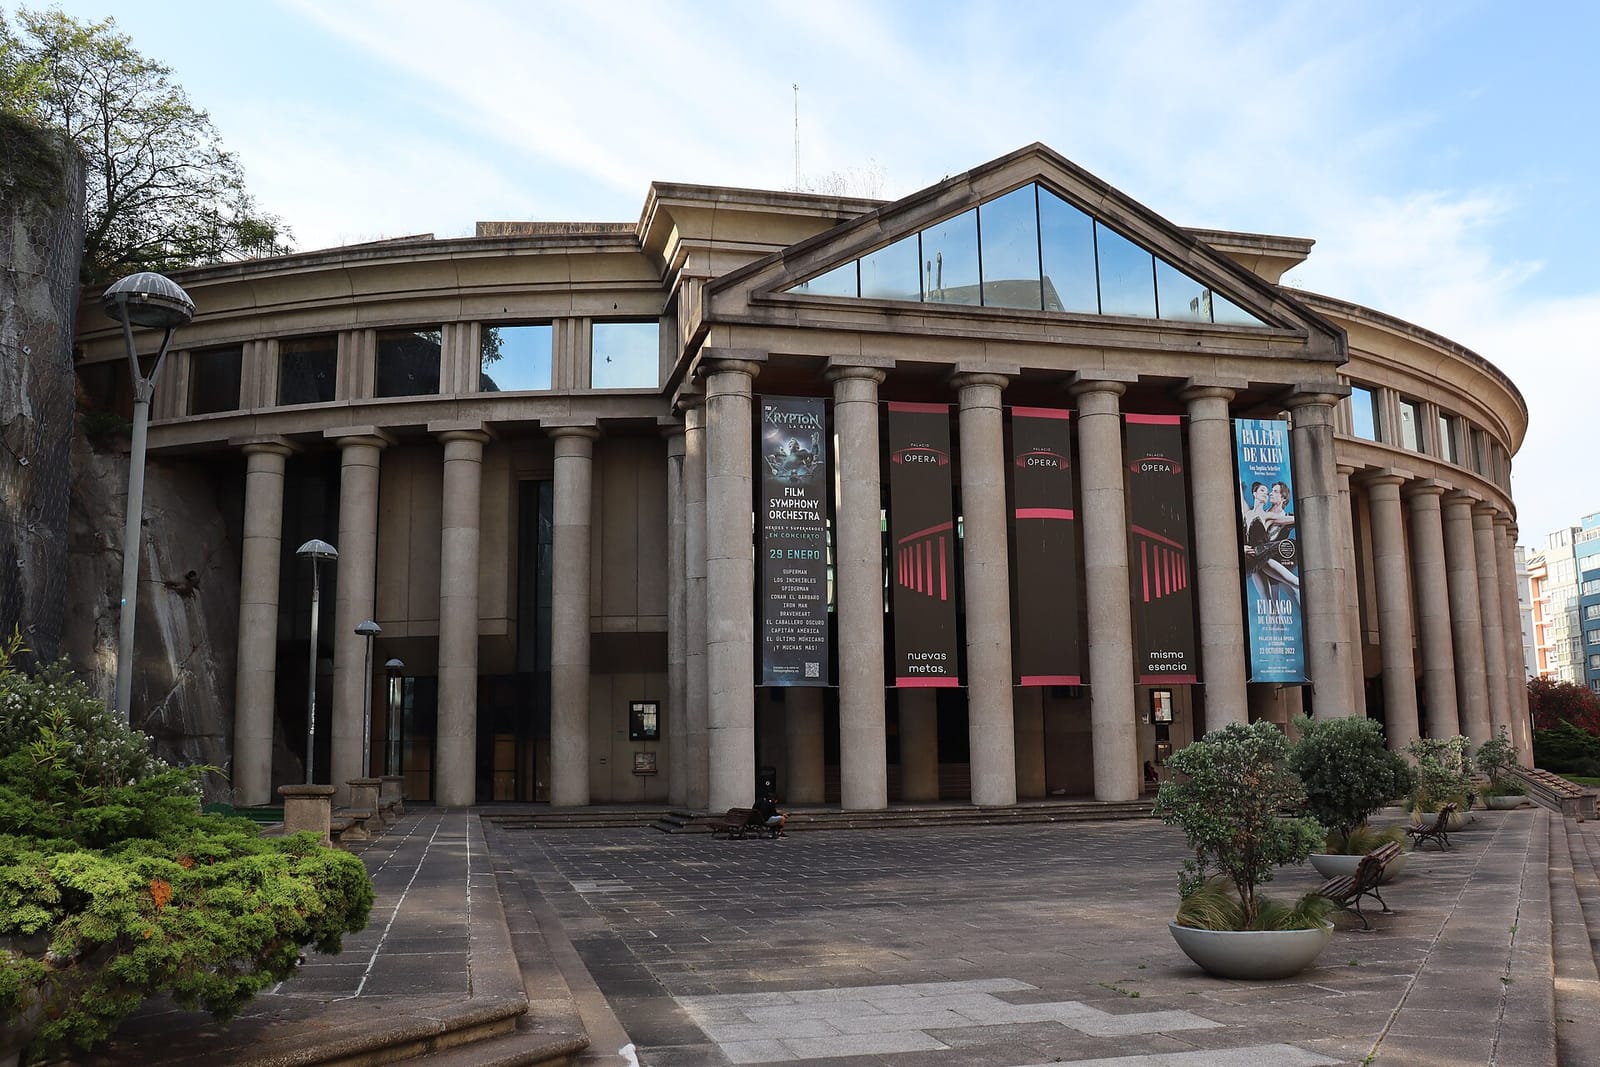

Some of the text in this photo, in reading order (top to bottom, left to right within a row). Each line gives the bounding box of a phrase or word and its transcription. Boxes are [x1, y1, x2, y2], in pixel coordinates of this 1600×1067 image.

[764, 406, 823, 430] KRYPTON
[1242, 429, 1283, 446] BALLET
[904, 454, 937, 463] ÓPERA
[1243, 447, 1257, 463] DE
[1027, 457, 1058, 467] ÓPERA
[1141, 463, 1171, 472] ÓPERA
[784, 487, 805, 497] FILM
[769, 498, 819, 509] SYMPHONY
[768, 510, 820, 521] ORCHESTRA
[769, 549, 820, 560] 29 ENERO
[1268, 600, 1293, 616] LAGO
[907, 652, 947, 660] nuevas
[1150, 650, 1184, 659] misma
[908, 663, 947, 674] metas,
[1148, 661, 1187, 671] esencia
